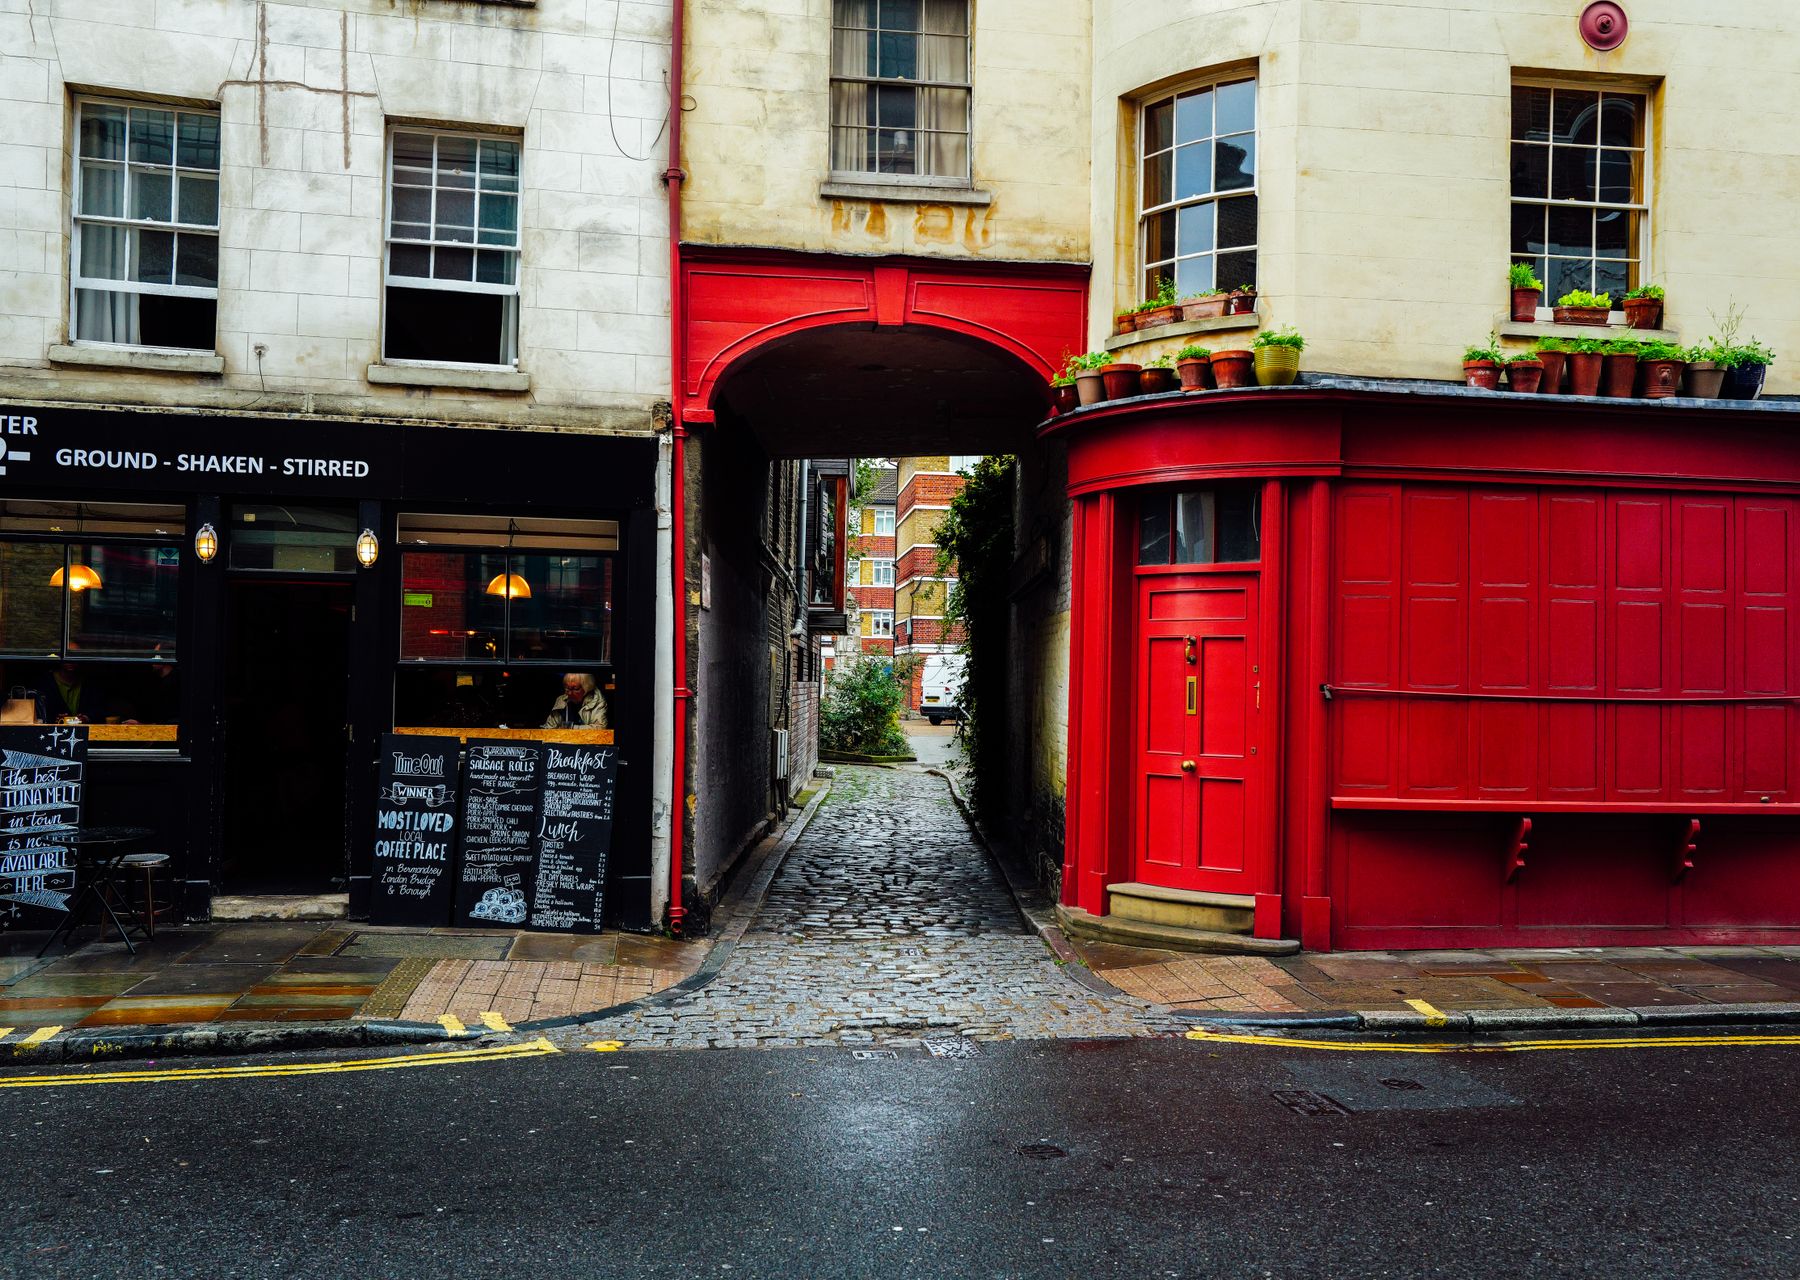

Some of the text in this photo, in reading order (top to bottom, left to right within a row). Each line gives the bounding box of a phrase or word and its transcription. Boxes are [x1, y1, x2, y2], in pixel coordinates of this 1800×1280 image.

[55, 448, 158, 470] GROUND
[176, 454, 264, 474] SHAKEN
[282, 457, 370, 478] STIRRED
[469, 760, 535, 772] SAUSAGE ROLLS
[547, 748, 614, 775] Breakfast
[5, 766, 70, 786] the best
[546, 771, 596, 782] BREAKFAST WRAP
[4, 785, 79, 807] TUNA MELT
[397, 786, 434, 799] WINNER
[8, 811, 63, 828] in town
[378, 810, 454, 833] MOST LOVED
[399, 831, 426, 843] LOCAL
[537, 816, 585, 843] Lunch
[8, 837, 21, 850] is
[375, 840, 447, 861] COFFEE PLACE
[0, 851, 68, 873] AVAILABLE
[385, 863, 443, 877] in Bermondsey
[15, 874, 48, 893] HERE
[381, 872, 436, 886] London Bridge
[575, 882, 595, 892] WRAPS
[387, 884, 431, 900] & Borough
